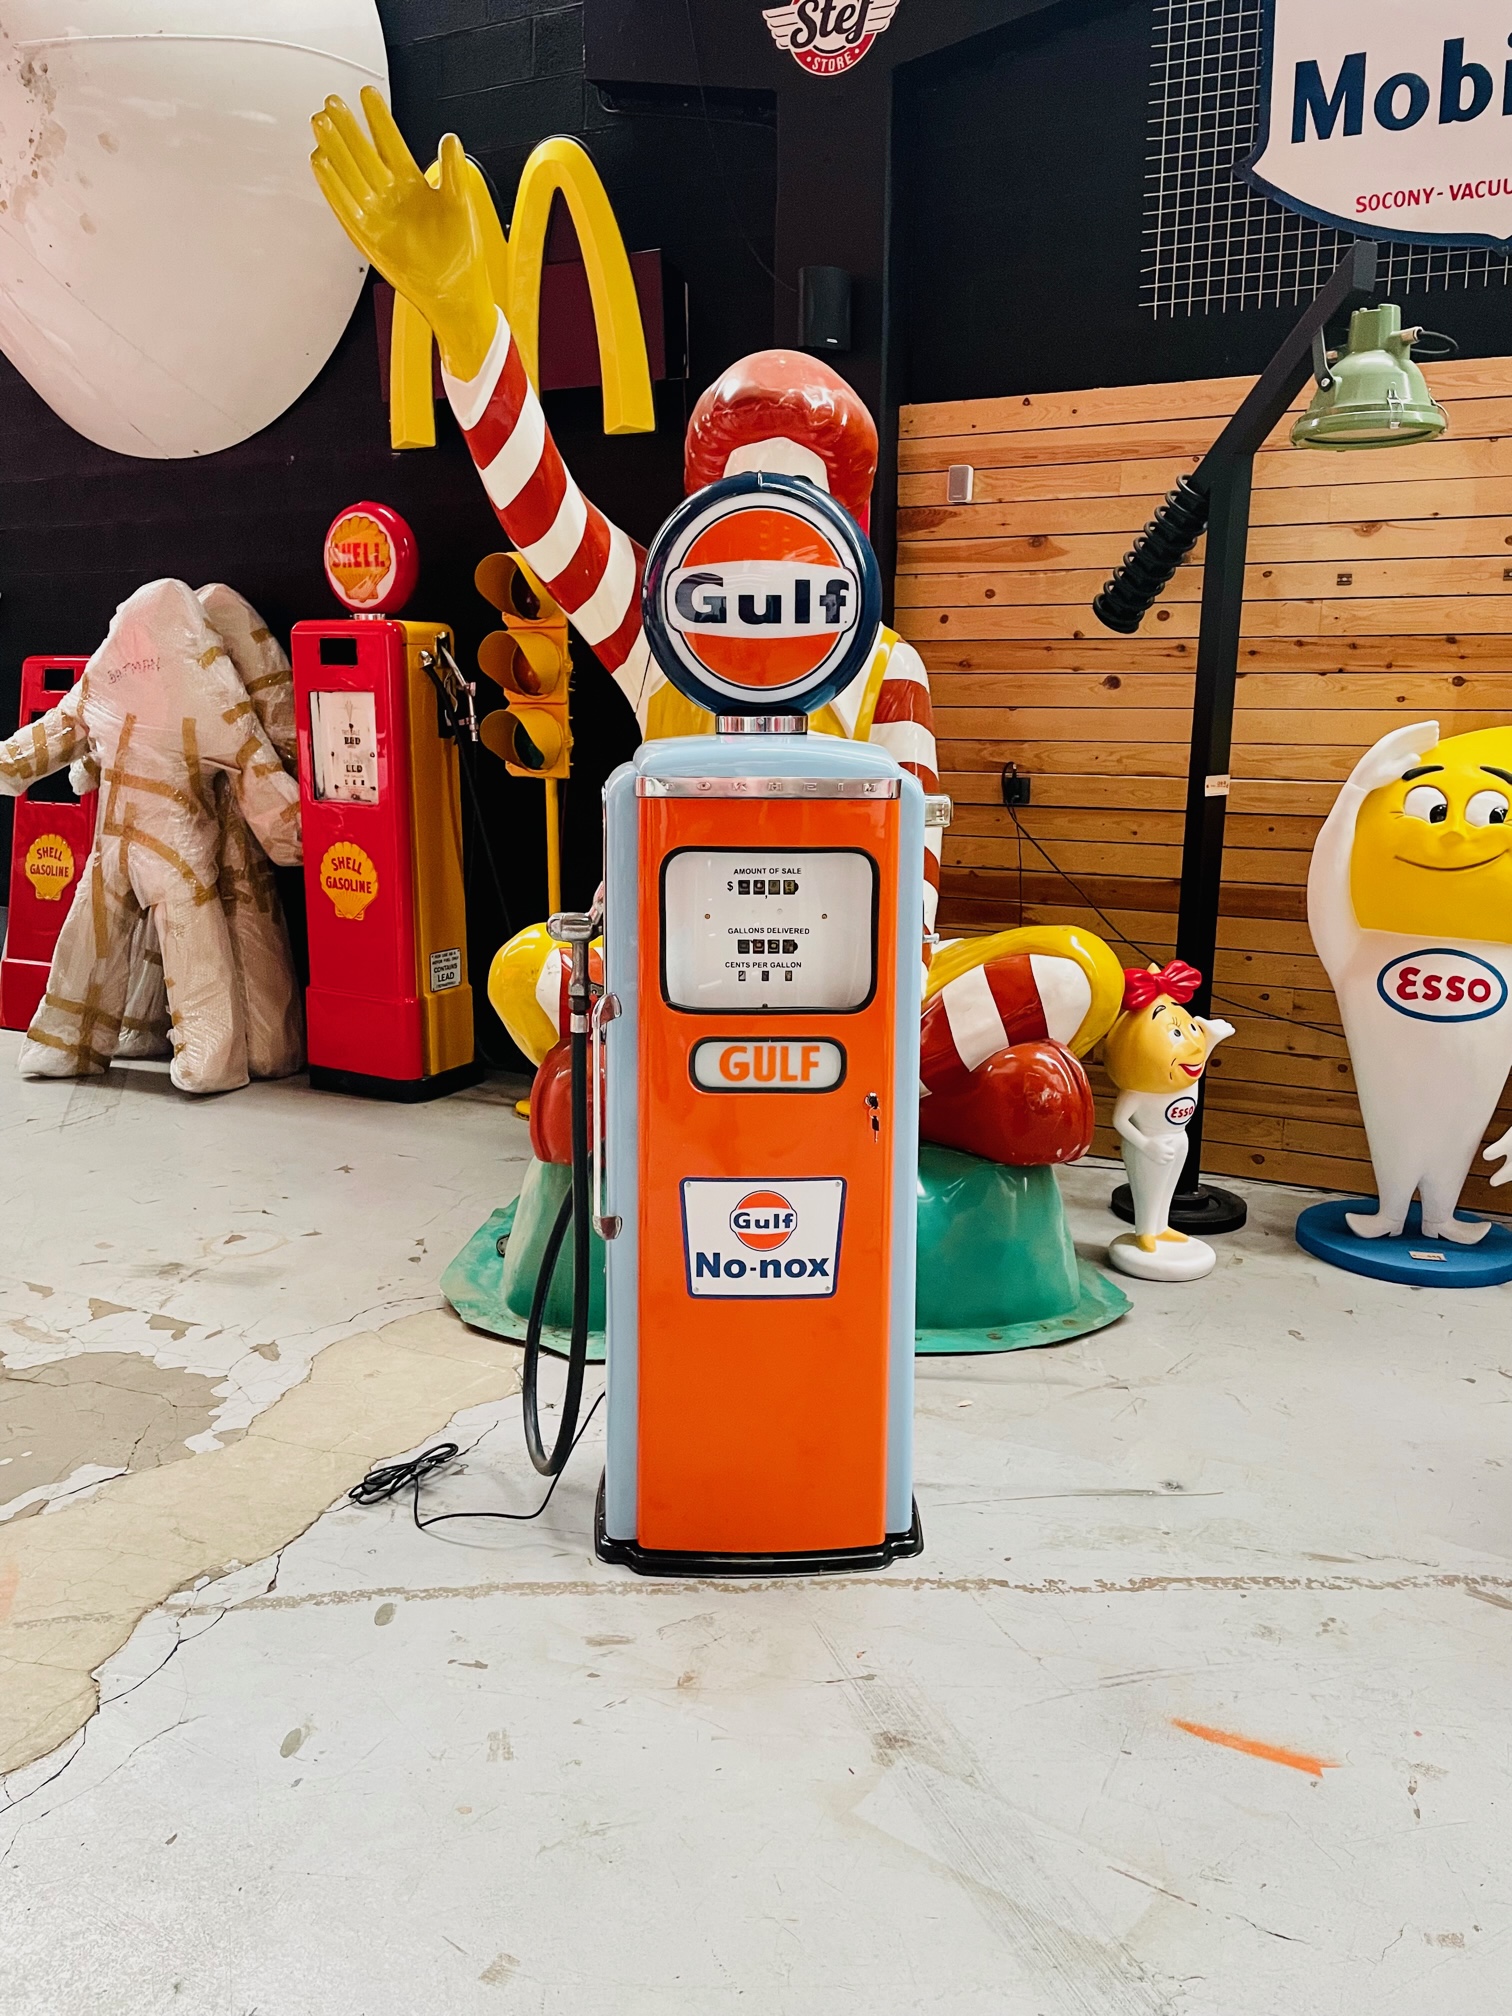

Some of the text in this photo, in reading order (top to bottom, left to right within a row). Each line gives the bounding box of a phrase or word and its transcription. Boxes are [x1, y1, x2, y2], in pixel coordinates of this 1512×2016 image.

[812, 52, 853, 72] STORE
[330, 542, 386, 568] SHELL
[675, 572, 849, 624] Gulf
[36, 846, 62, 861] SHELL
[30, 864, 69, 877] GASOLINE
[331, 856, 362, 875] SHELL
[326, 876, 372, 894] GASOLINE
[767, 927, 810, 935] DELIVERED
[437, 972, 455, 982] LEAD
[719, 1045, 820, 1082] GULF
[733, 1212, 794, 1229] Gulf
[696, 1252, 830, 1278] No-nox
